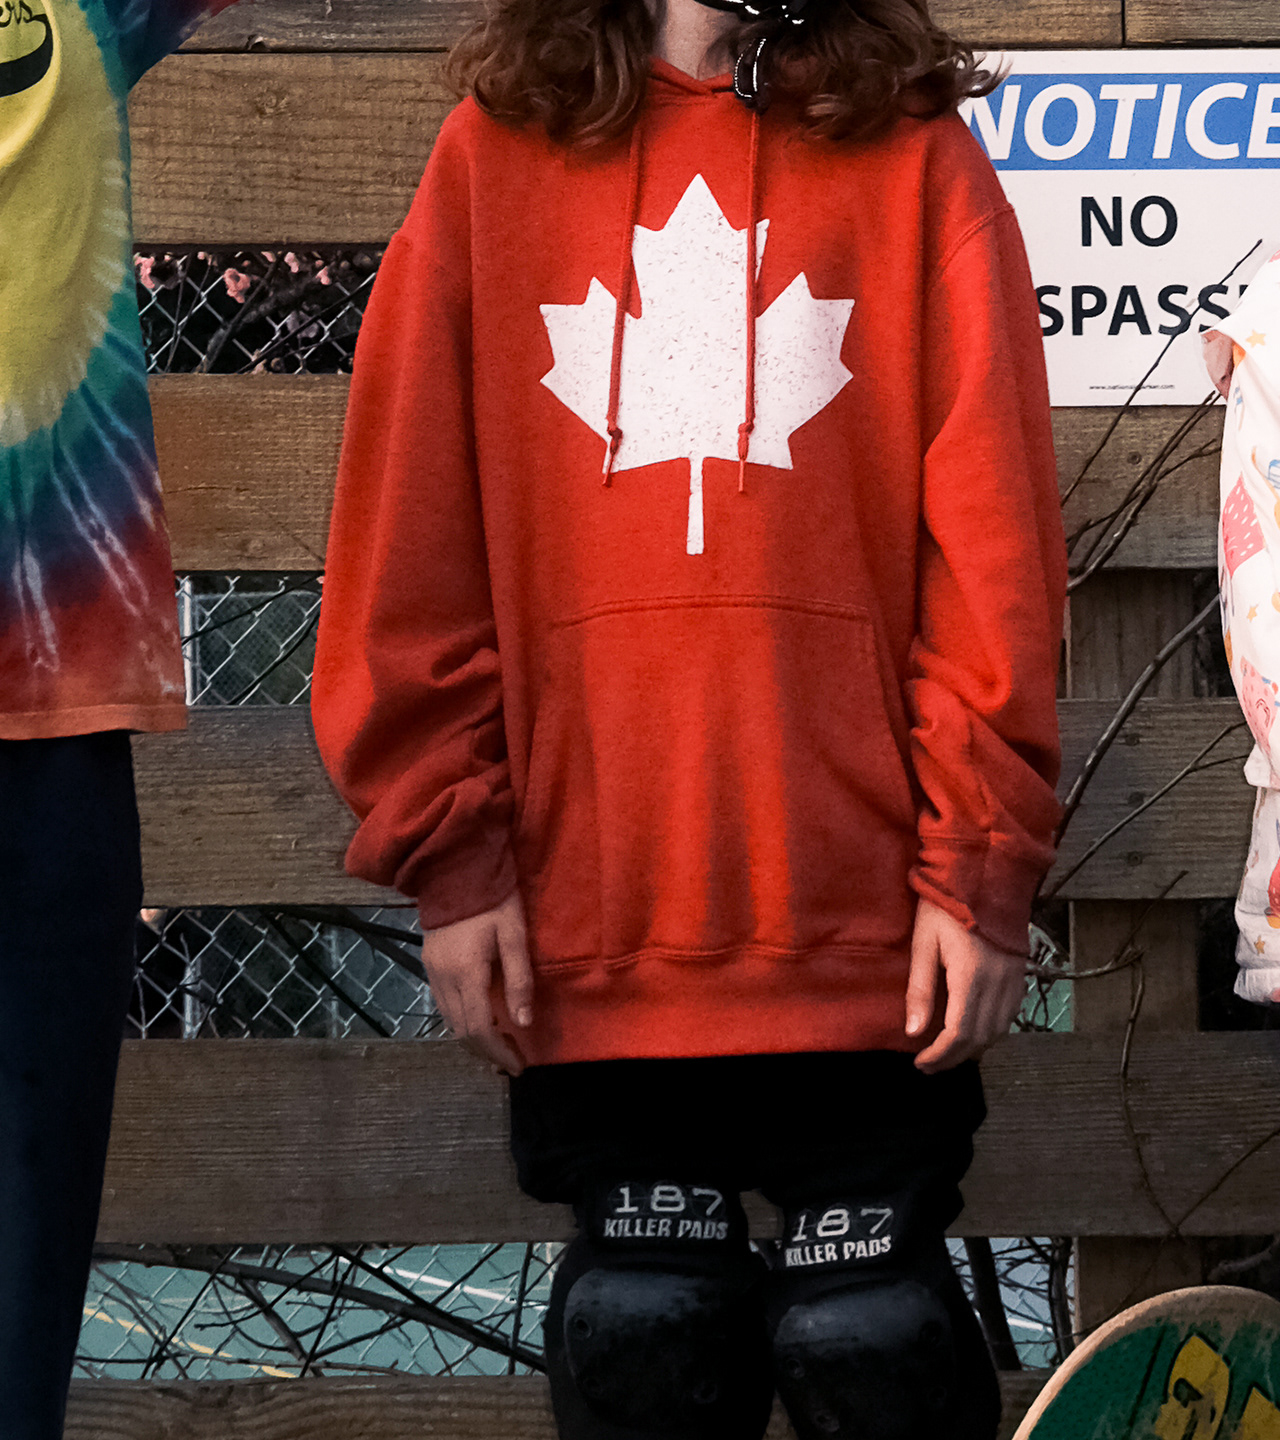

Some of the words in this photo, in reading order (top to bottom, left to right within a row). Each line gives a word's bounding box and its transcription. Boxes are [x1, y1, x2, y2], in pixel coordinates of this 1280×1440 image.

[1081, 195, 1178, 247] NO
[1035, 284, 1248, 336] SPASS
[616, 1185, 722, 1216] 187
[604, 1218, 672, 1238] KILLER
[676, 1219, 729, 1240] PADS
[792, 1208, 894, 1242] 187
[785, 1242, 838, 1268] KILLER
[843, 1234, 892, 1260] PADS
